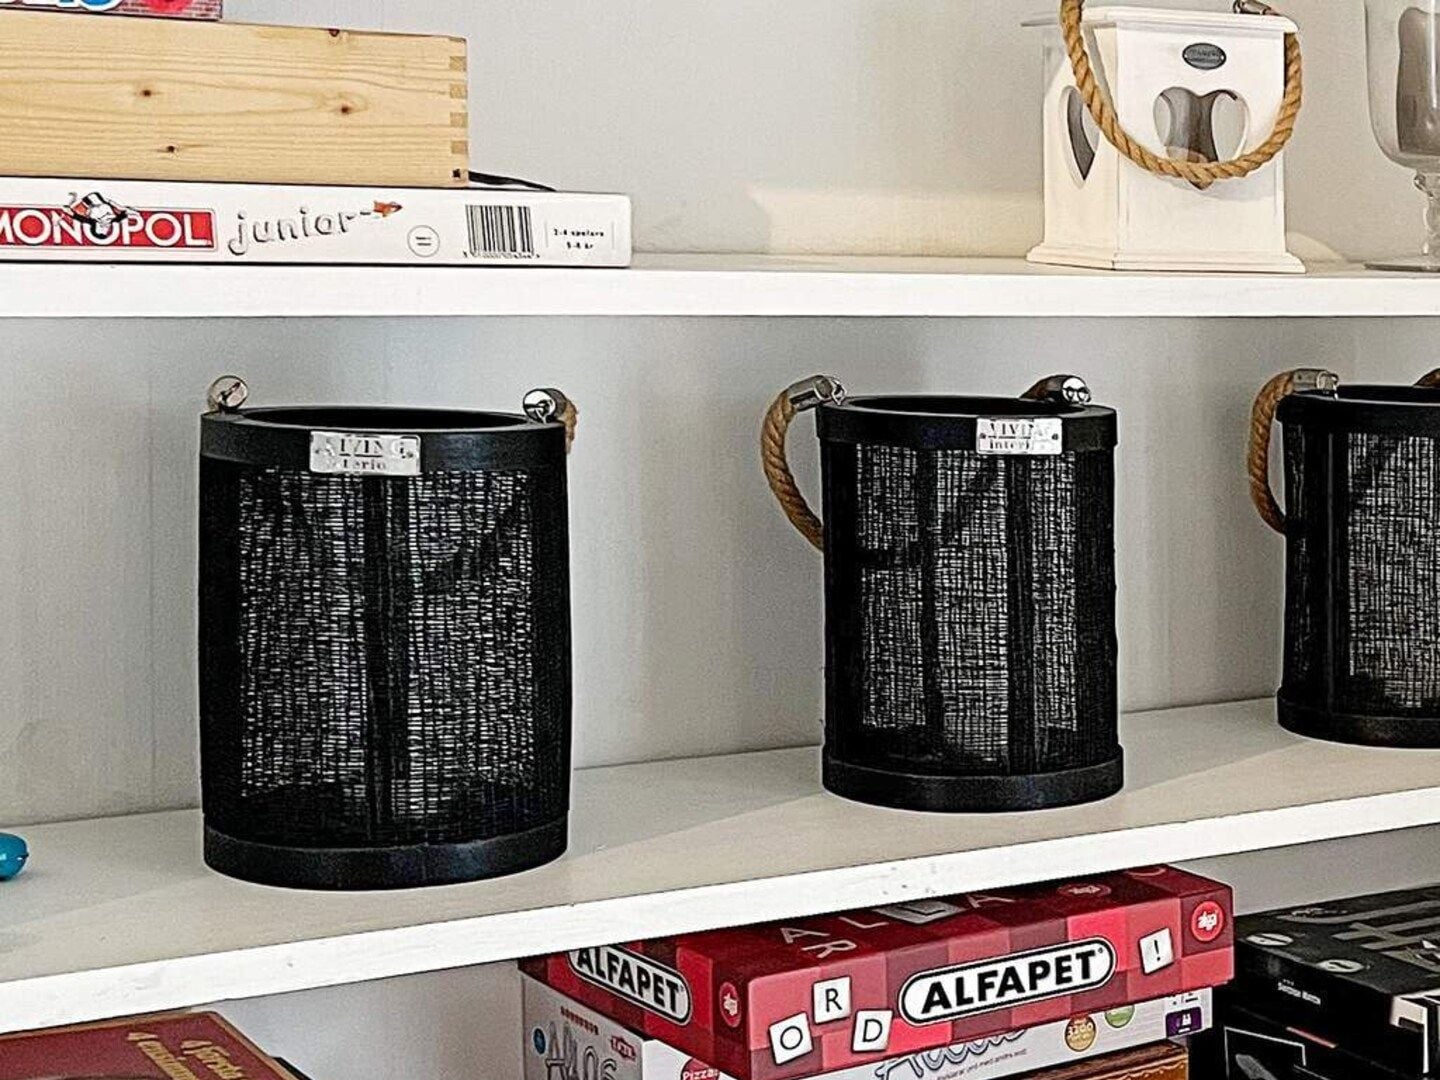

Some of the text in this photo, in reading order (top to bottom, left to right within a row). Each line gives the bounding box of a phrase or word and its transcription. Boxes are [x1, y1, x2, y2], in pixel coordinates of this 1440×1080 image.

[228, 206, 357, 256] junior
[577, 948, 680, 1013] ALFAPET
[920, 950, 1096, 1014] ALFAPET
